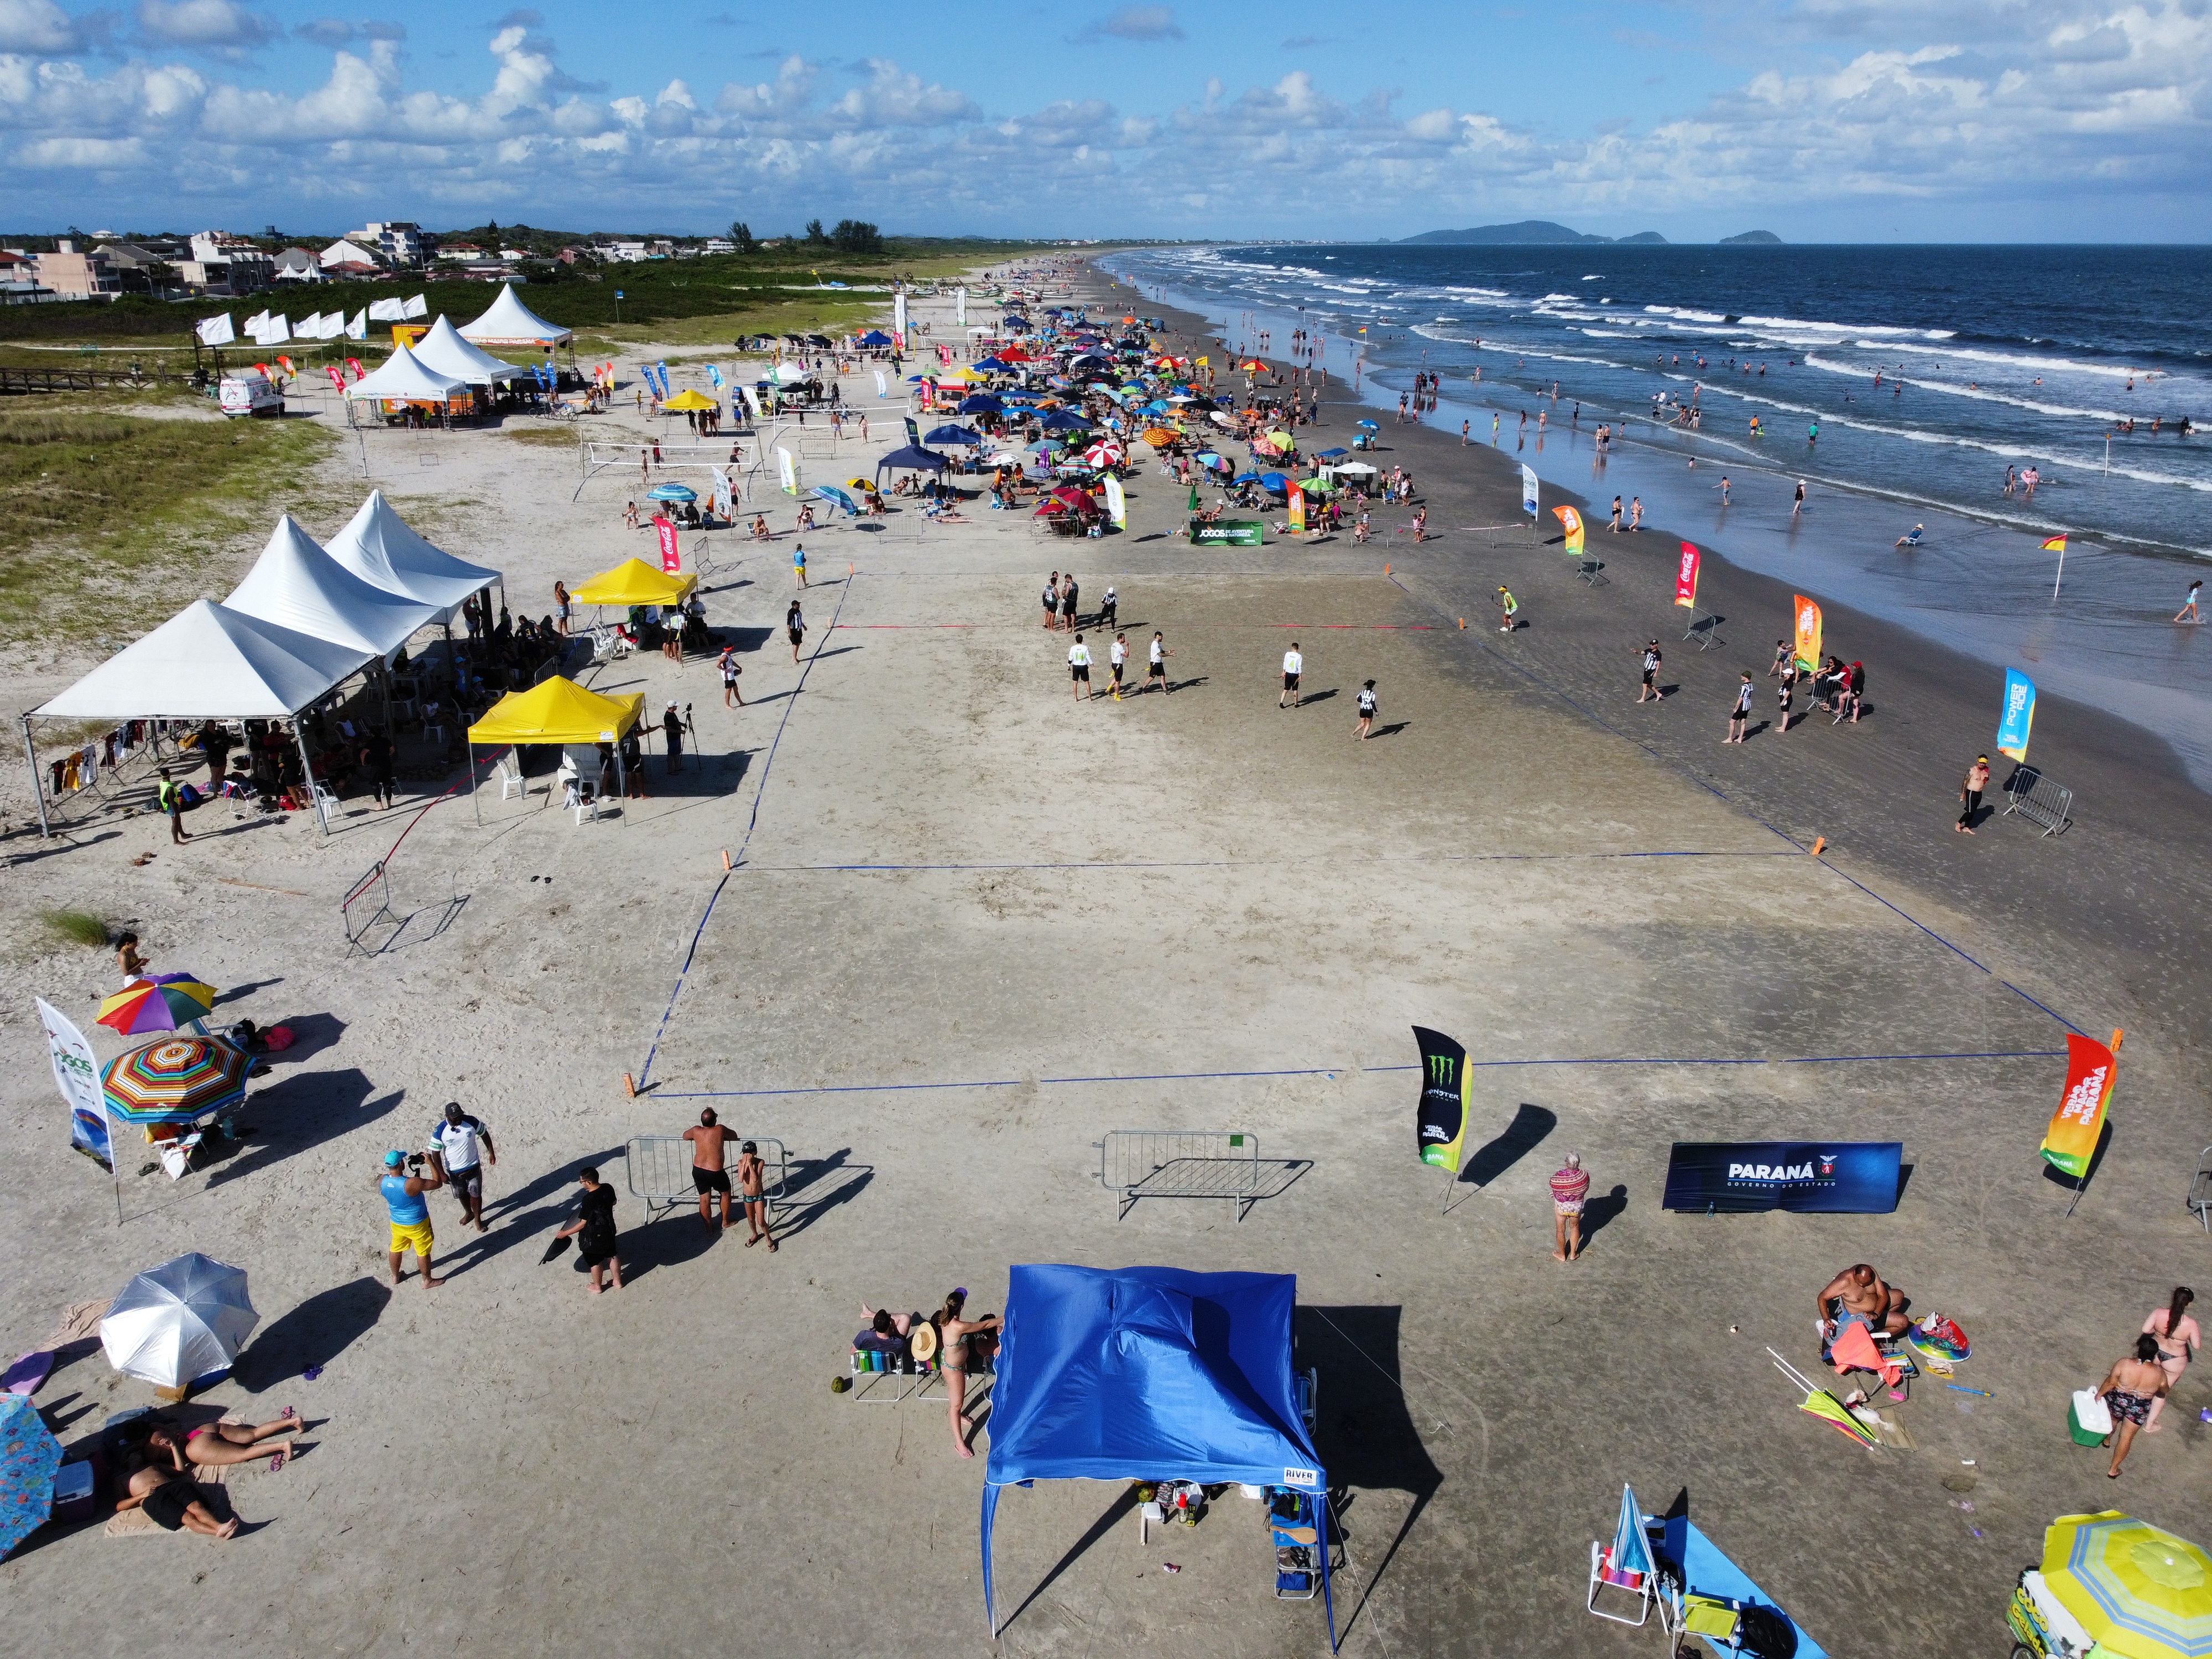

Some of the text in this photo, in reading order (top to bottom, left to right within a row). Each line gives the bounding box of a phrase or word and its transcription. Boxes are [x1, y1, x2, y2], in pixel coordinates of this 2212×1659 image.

[1199, 529, 1225, 538] JOGOS
[2006, 684, 2019, 727] POWER
[2017, 684, 2027, 711] ADE
[623, 743, 630, 754] 7
[2079, 1066, 2107, 1125] PARANÁ
[1729, 1162, 1814, 1180] PARANÁ
[1286, 1469, 1312, 1479] RIVER
